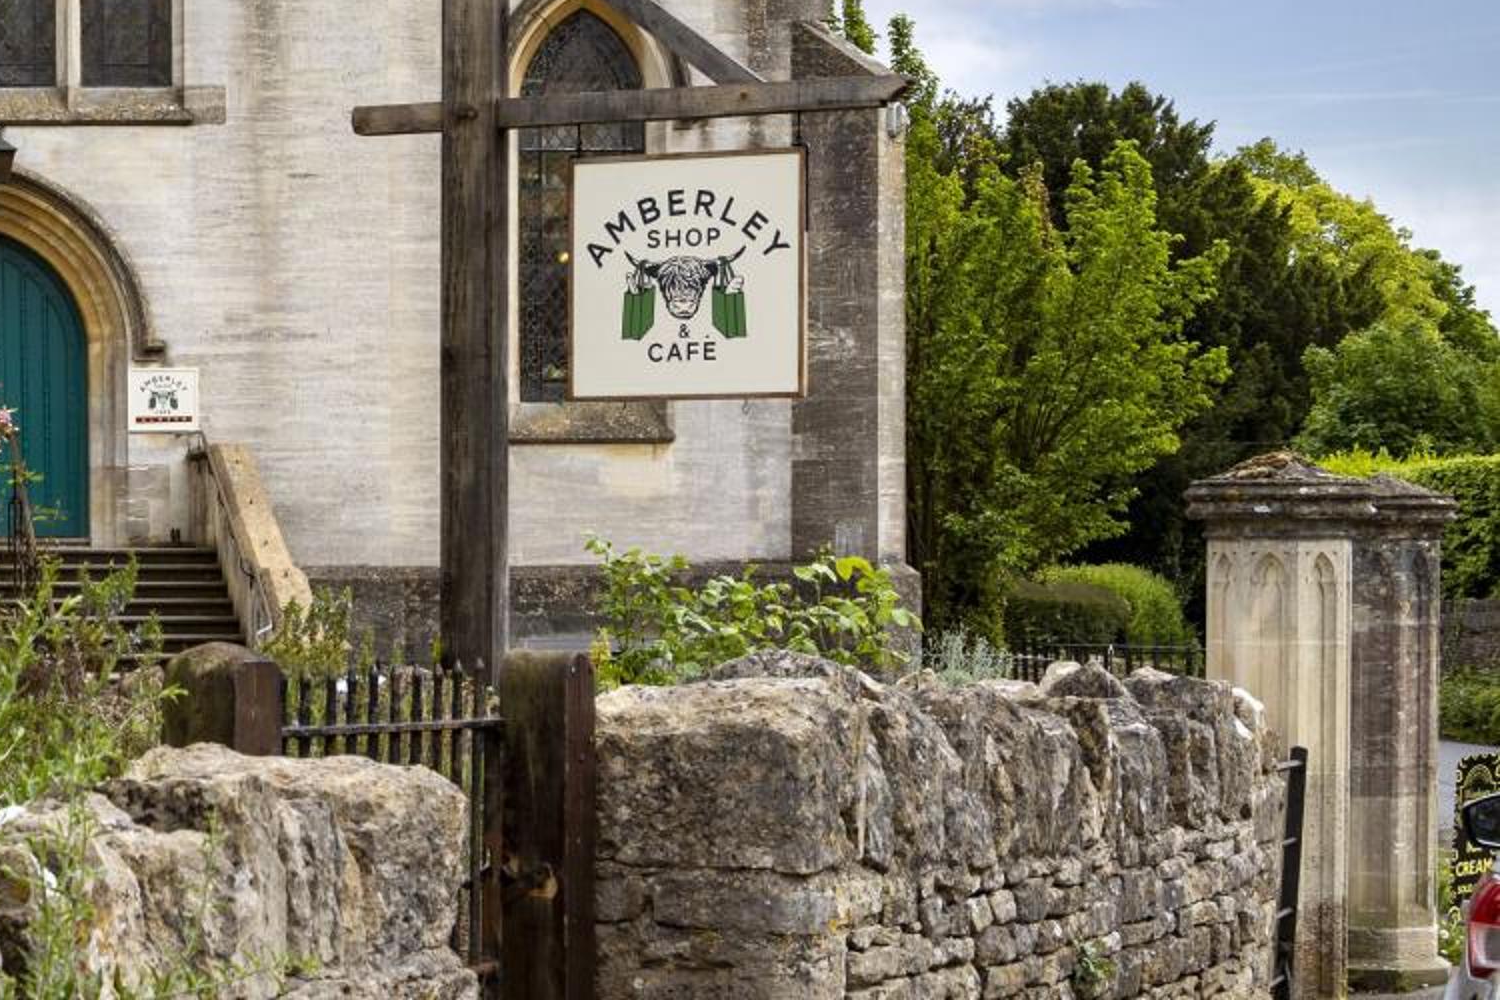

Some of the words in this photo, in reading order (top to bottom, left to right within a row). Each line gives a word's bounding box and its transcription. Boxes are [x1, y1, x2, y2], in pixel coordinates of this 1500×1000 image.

[586, 189, 791, 268] AMBERLEY
[646, 227, 721, 249] SHOP
[678, 323, 691, 339] &
[1455, 857, 1493, 877] CREAM
